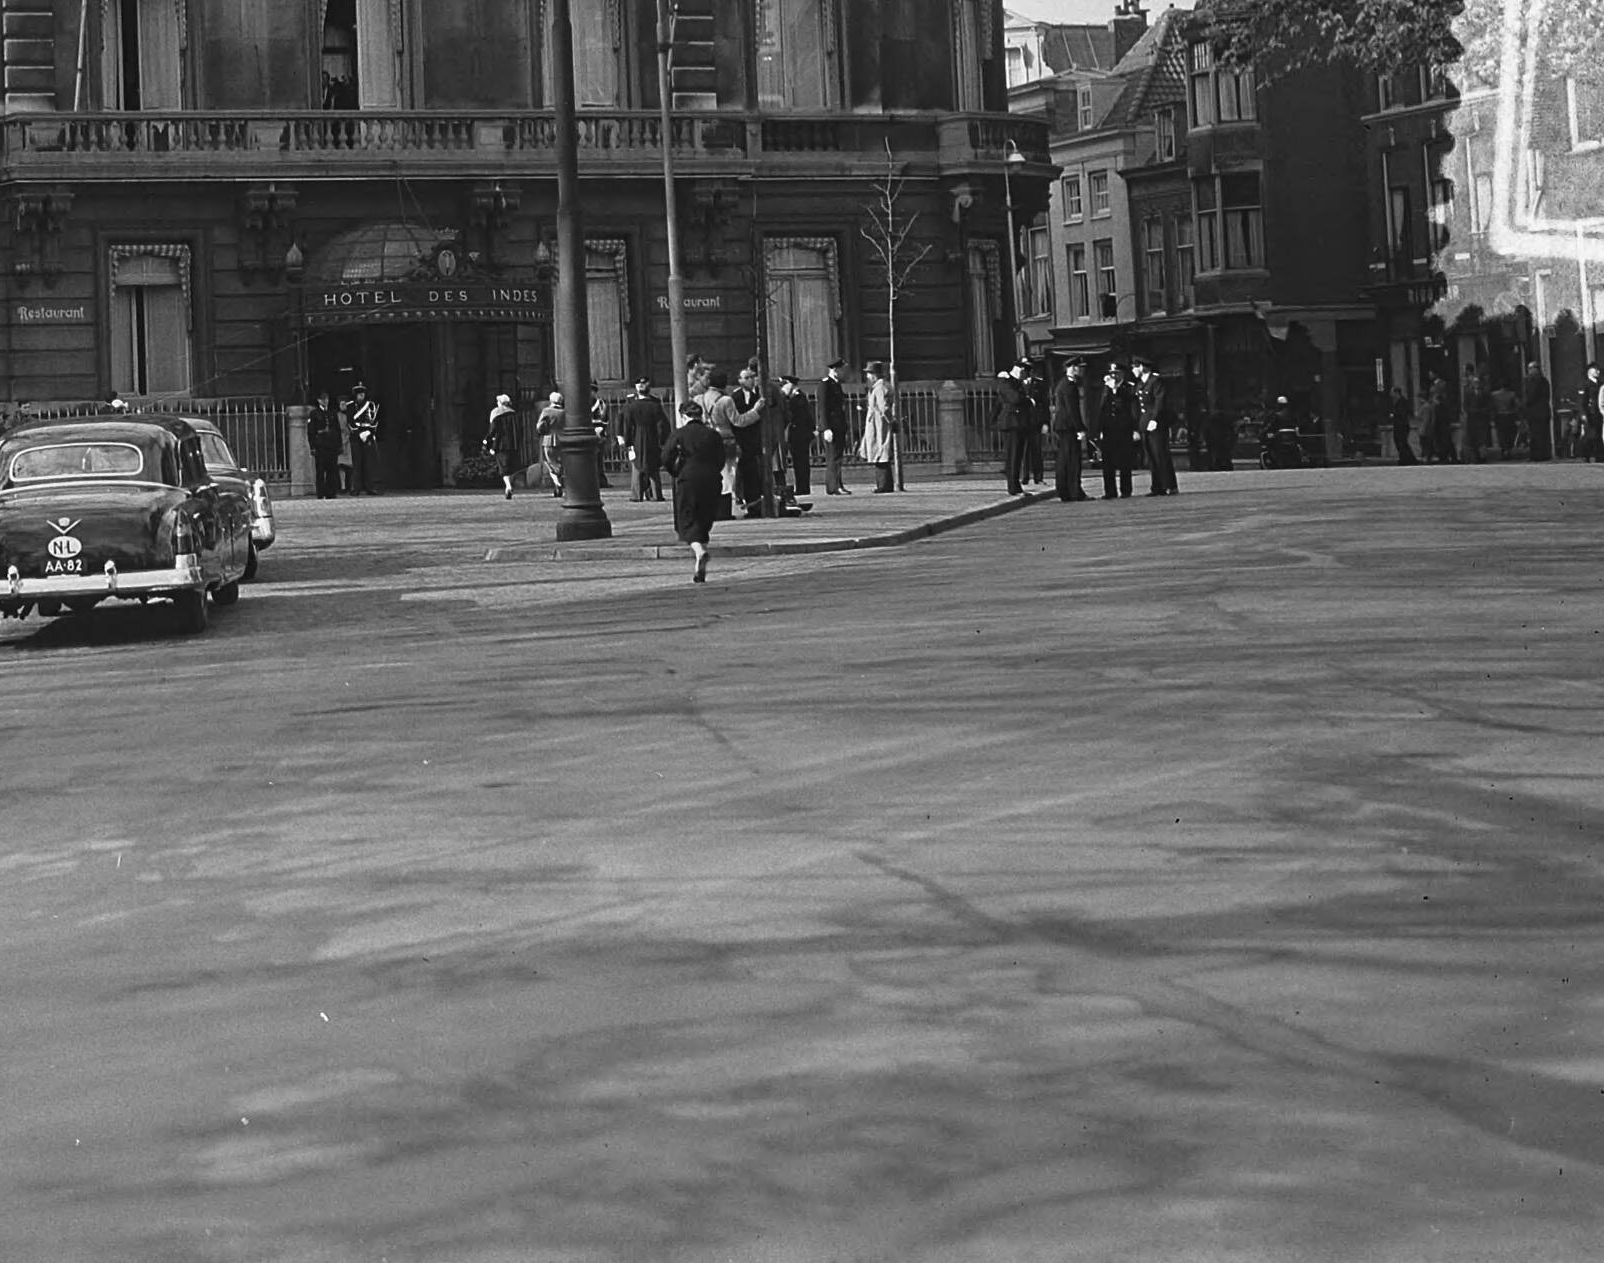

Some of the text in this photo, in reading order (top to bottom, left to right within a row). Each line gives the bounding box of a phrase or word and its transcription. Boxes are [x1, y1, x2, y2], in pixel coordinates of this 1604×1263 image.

[324, 289, 538, 306] HOTEL DES INDES
[657, 295, 720, 309] Raurant
[17, 305, 84, 321] Restaurant
